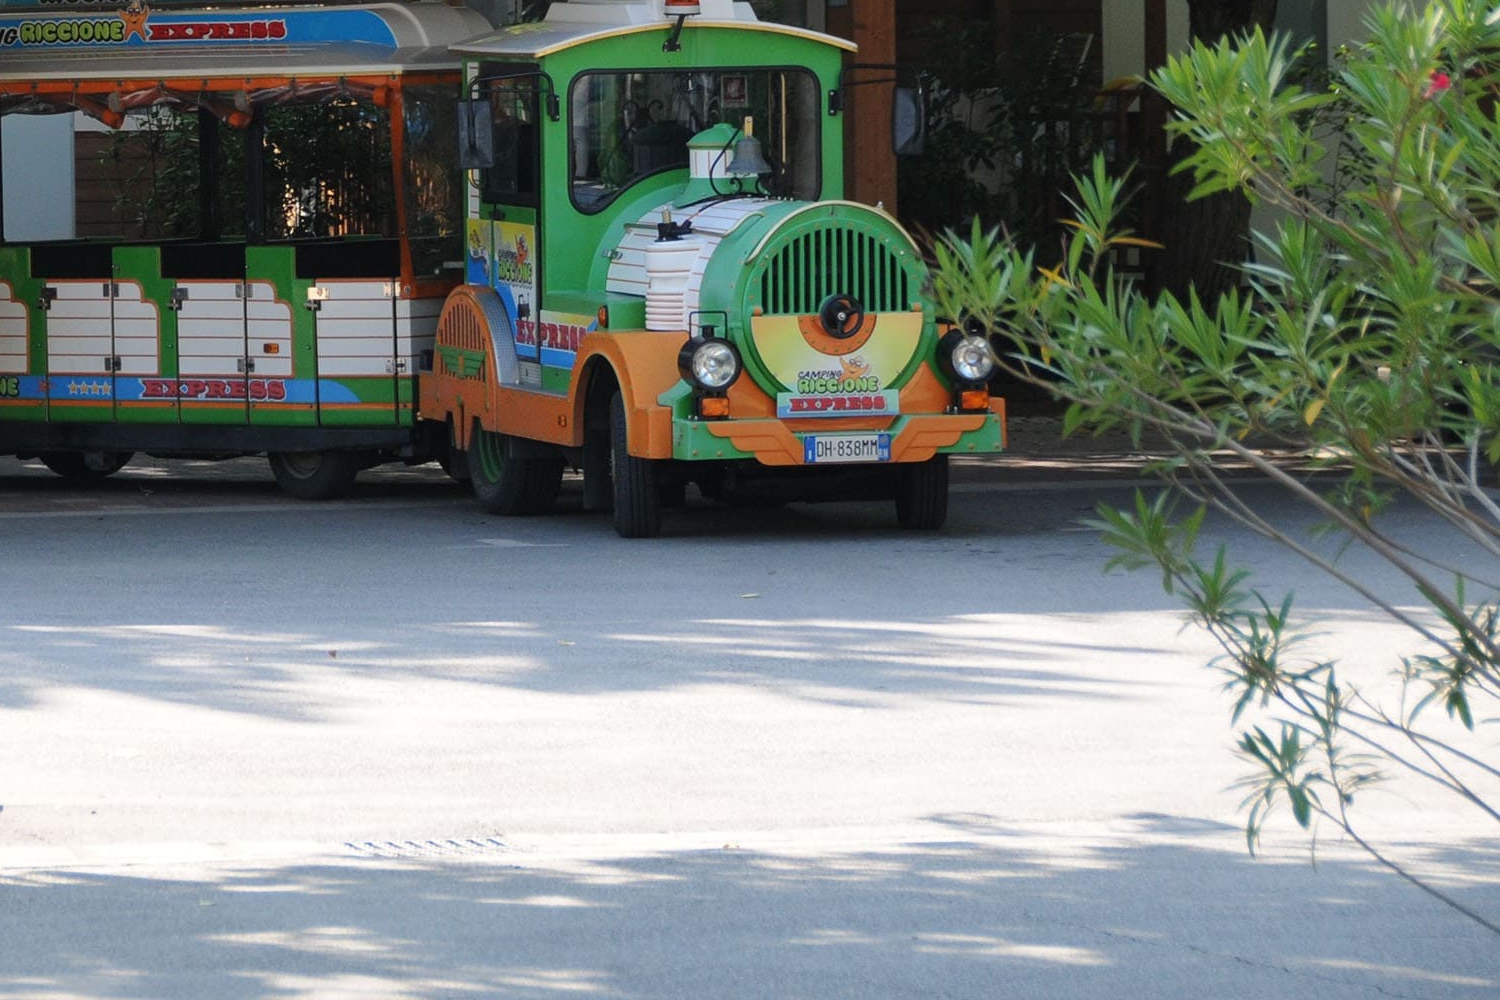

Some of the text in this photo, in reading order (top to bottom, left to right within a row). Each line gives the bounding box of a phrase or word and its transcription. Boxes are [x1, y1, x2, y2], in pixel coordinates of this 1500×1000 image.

[19, 21, 124, 44] RICCIONE
[148, 20, 286, 42] EXPRESS
[797, 370, 842, 379] CAMPING
[140, 379, 287, 400] EXPRESS
[798, 376, 879, 394] RICCIONE
[789, 396, 886, 412] EXPRESS
